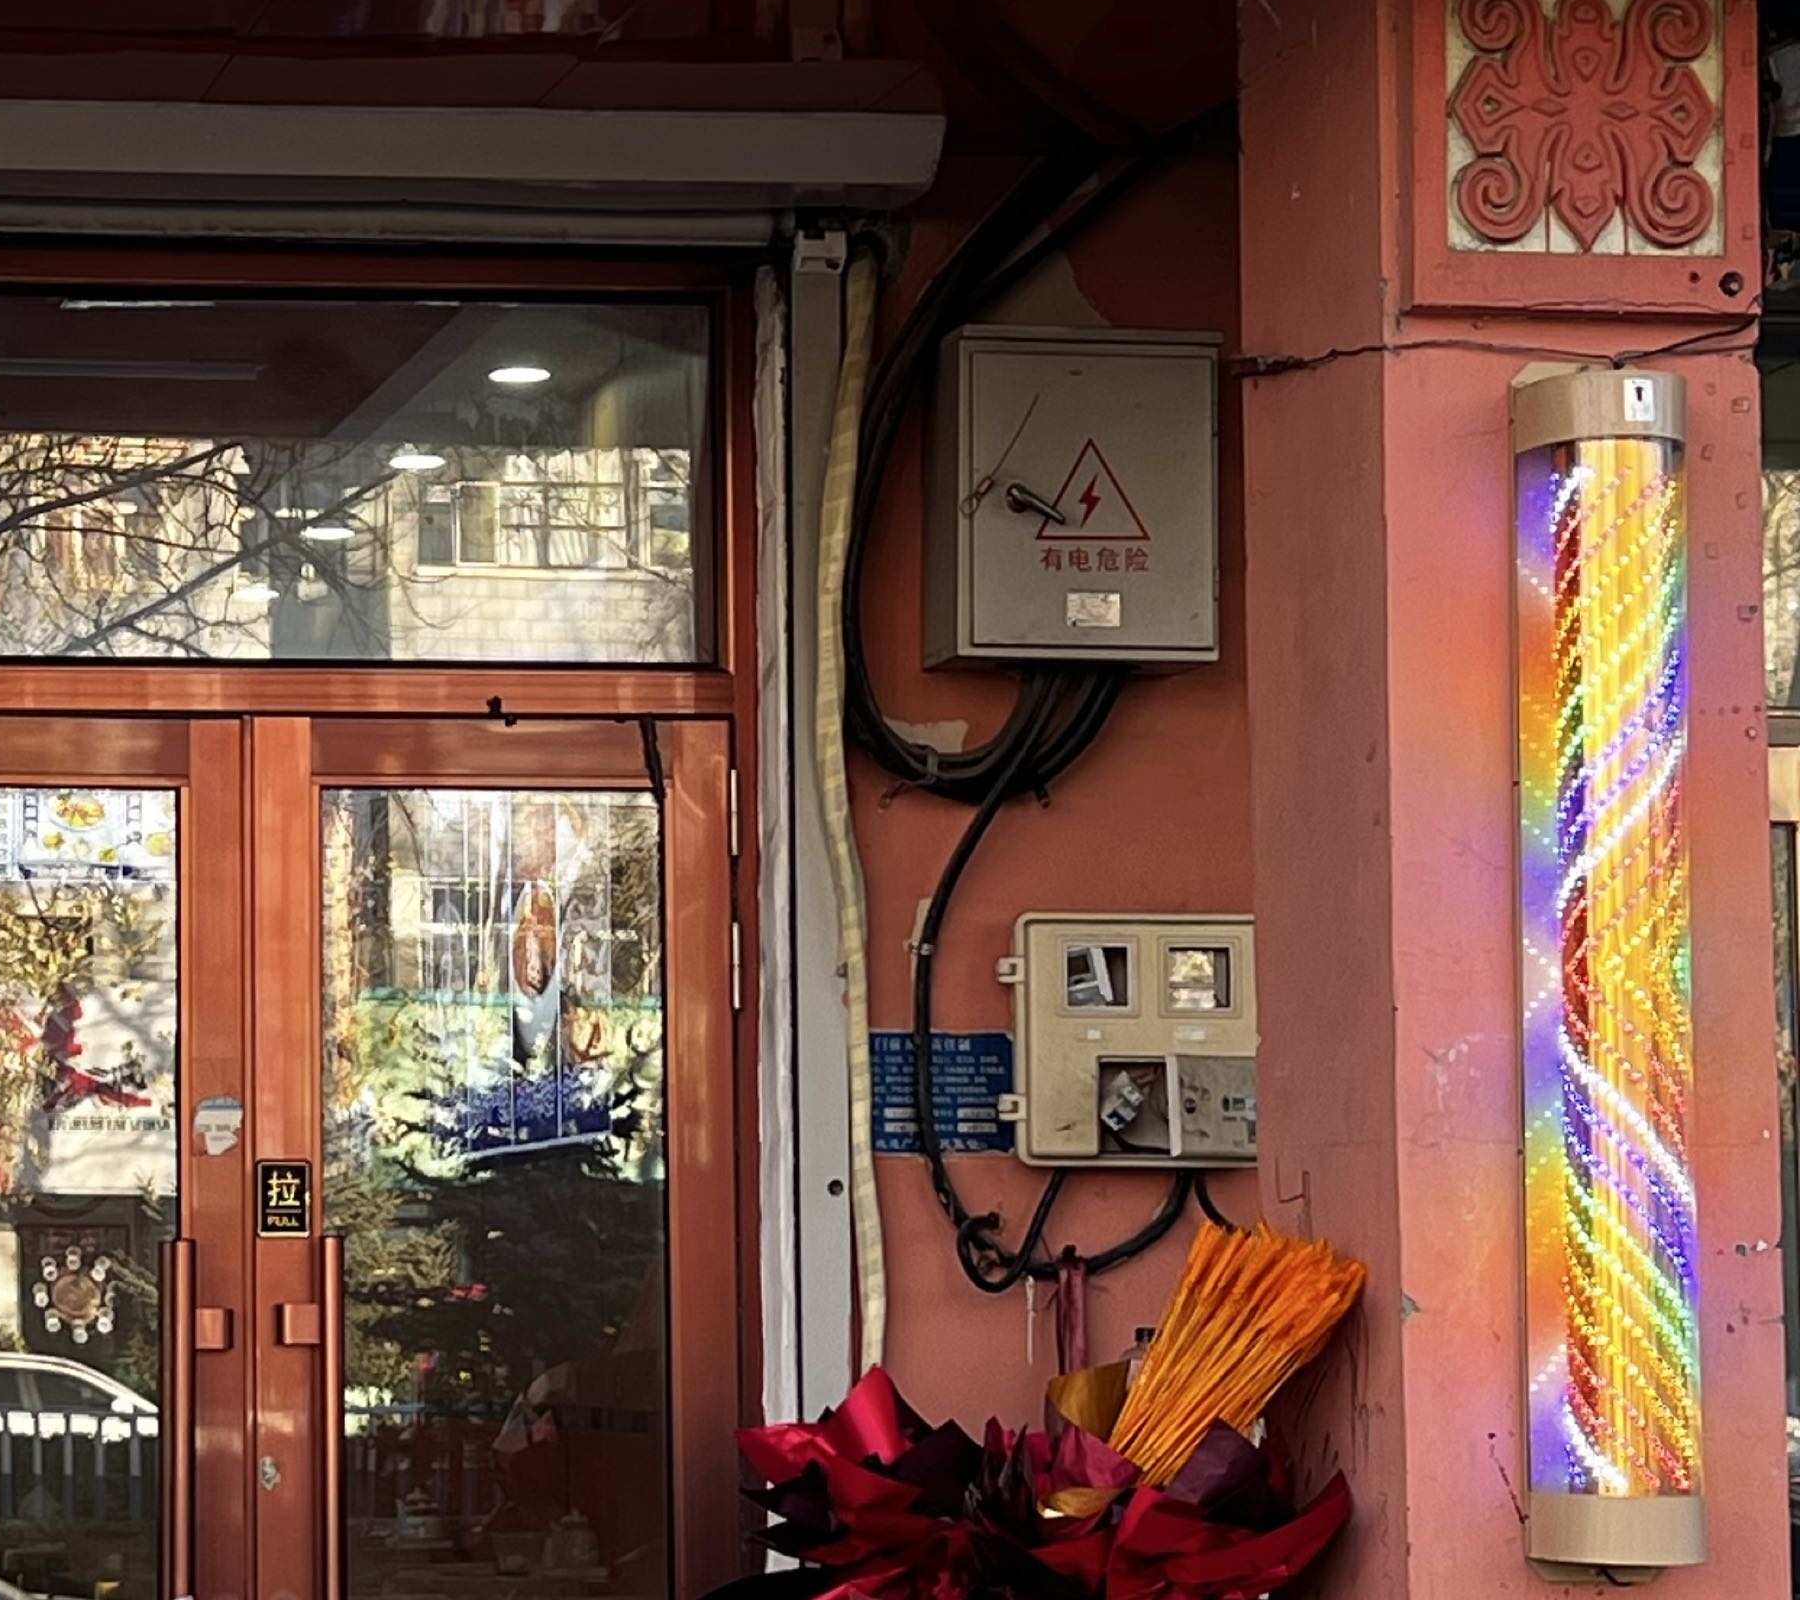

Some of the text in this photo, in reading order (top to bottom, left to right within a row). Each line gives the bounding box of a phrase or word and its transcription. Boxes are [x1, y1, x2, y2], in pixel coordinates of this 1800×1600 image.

[1040, 546, 1150, 573] 有电危险
[267, 1171, 301, 1207] 拉
